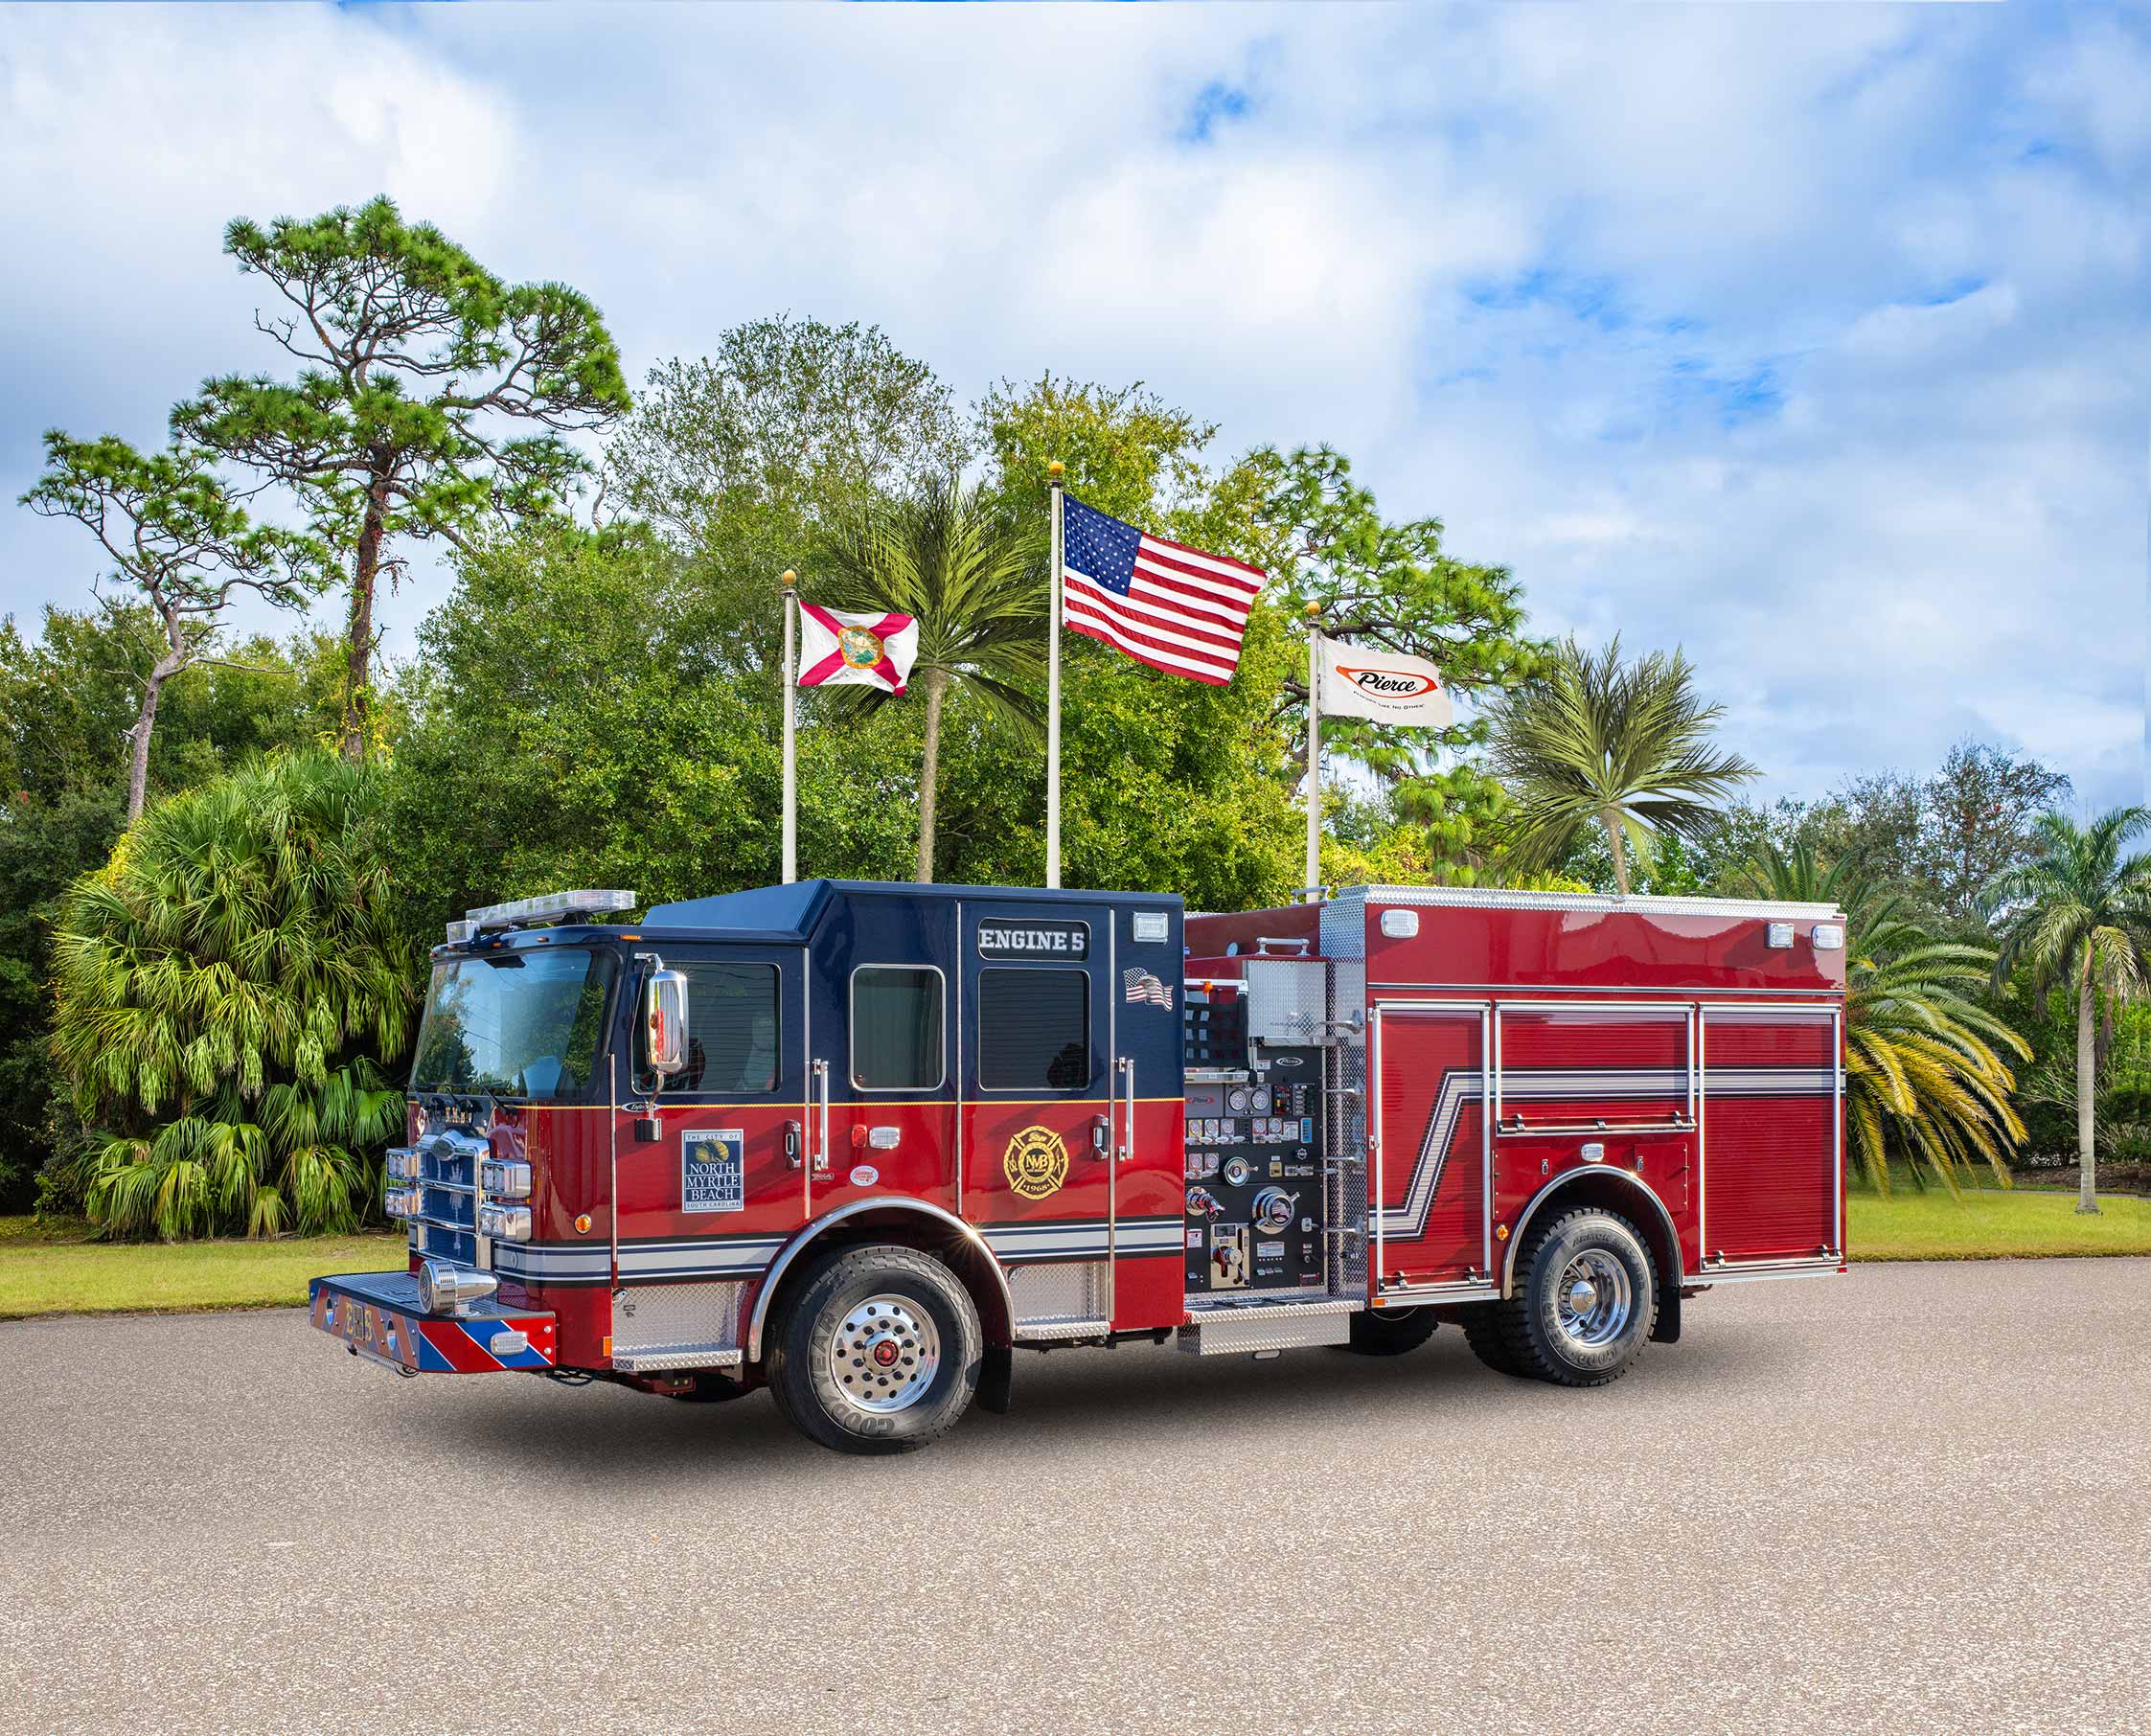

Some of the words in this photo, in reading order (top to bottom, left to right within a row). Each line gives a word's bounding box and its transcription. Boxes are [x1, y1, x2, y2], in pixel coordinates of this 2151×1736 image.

[1358, 672, 1416, 692] Pierce
[979, 929, 1067, 950] ENGINE
[1071, 932, 1085, 951] 5
[690, 1162, 735, 1175] NORTH
[687, 1175, 739, 1187] MYRTLE
[691, 1188, 735, 1200] BEACH
